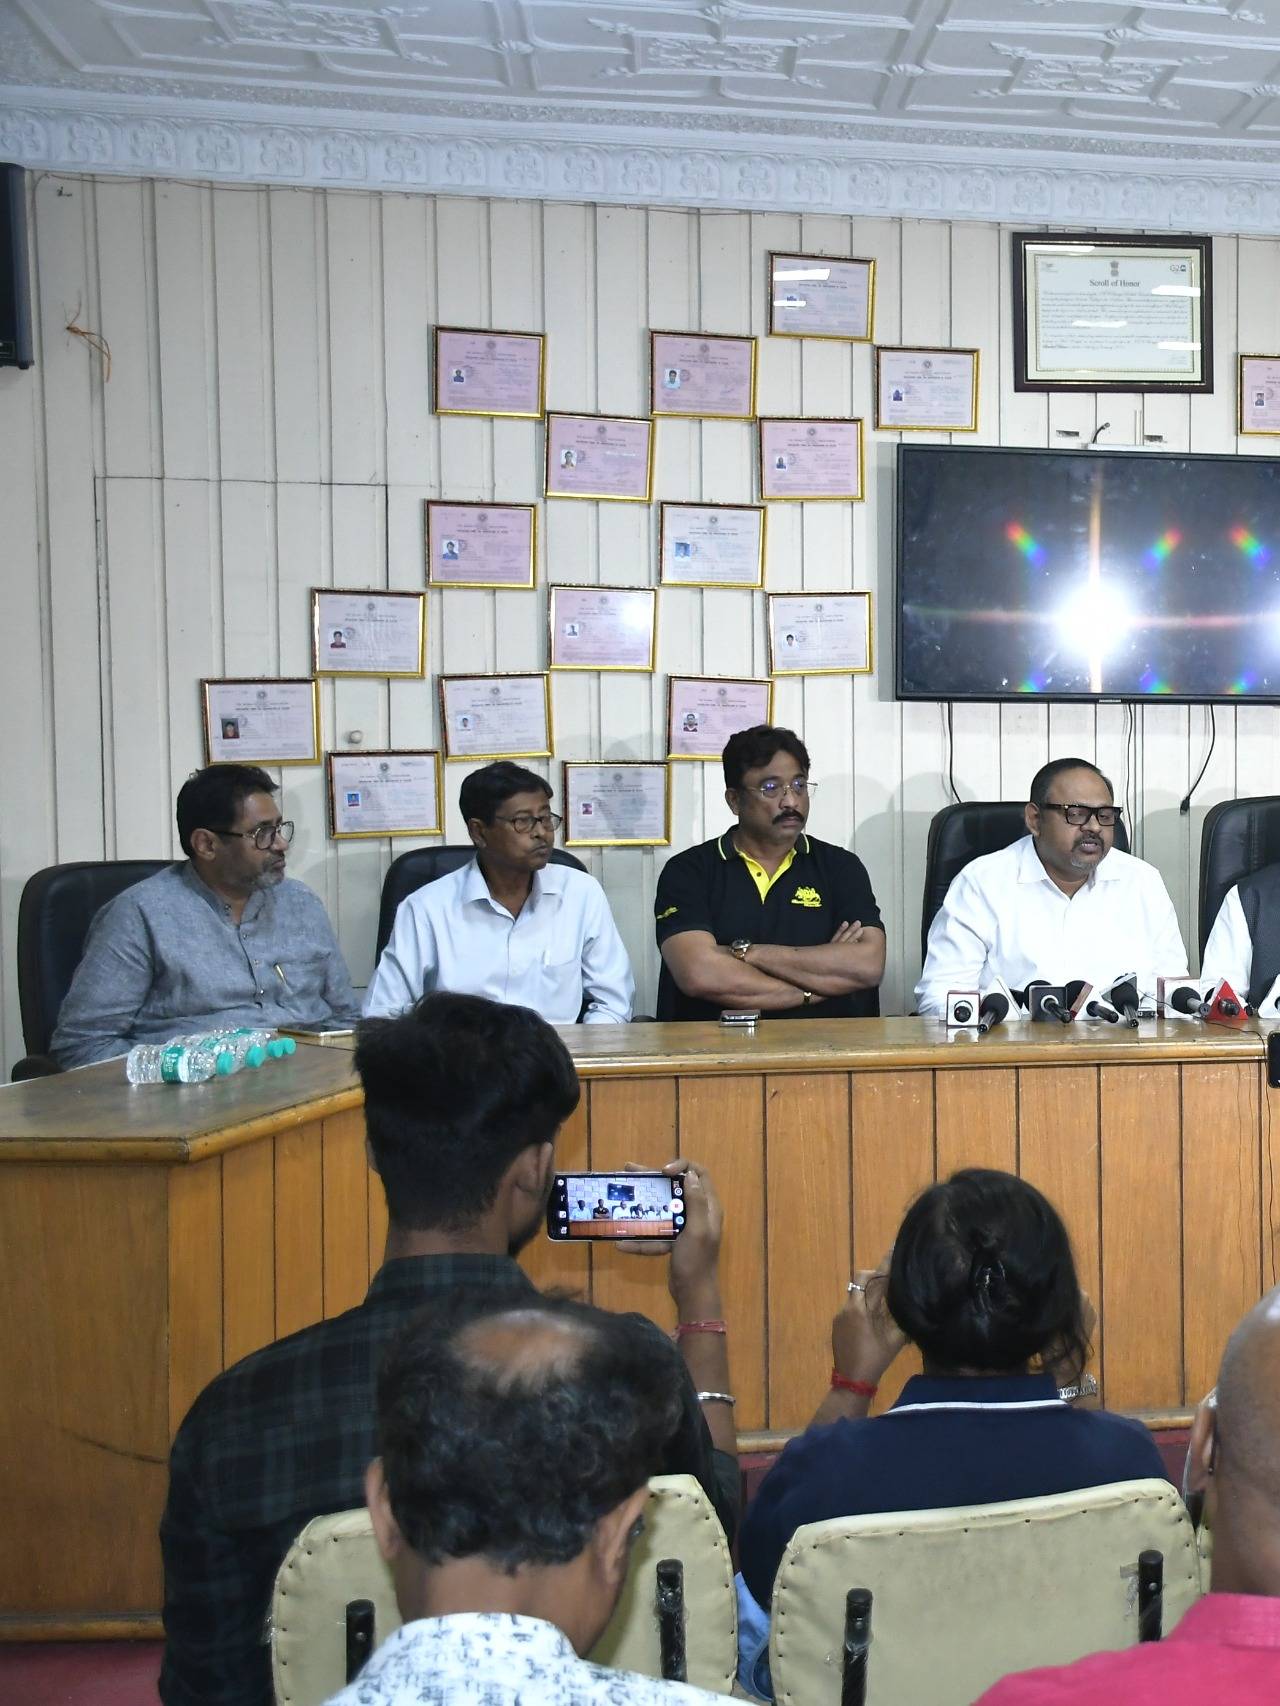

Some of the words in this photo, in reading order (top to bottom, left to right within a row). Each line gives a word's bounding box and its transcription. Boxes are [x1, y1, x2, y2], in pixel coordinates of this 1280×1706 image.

[1089, 279, 1110, 287] Scroll
[1111, 279, 1118, 287] of
[1119, 279, 1140, 287] Honor
